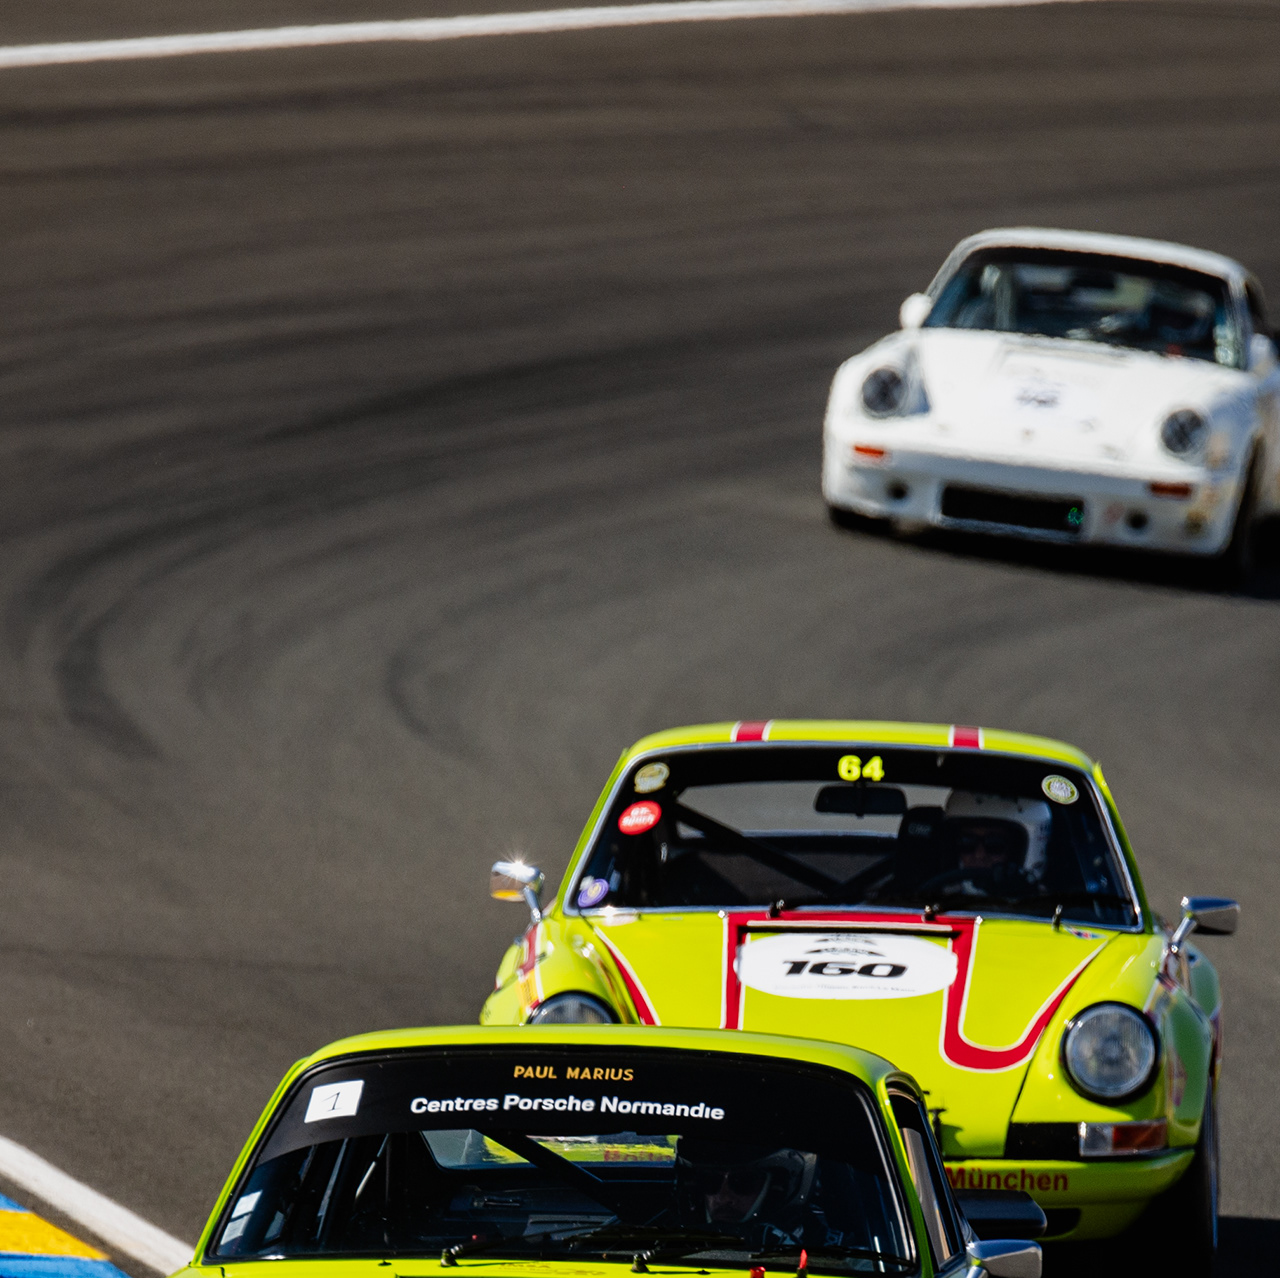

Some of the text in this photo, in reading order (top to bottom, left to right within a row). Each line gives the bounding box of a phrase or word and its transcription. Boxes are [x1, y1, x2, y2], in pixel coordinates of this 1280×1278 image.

[837, 754, 885, 782] 64
[783, 960, 908, 978] 160
[513, 1066, 634, 1081] PAUL MARIUS
[410, 1097, 499, 1115] Centres
[503, 1095, 595, 1113] Porsche
[945, 1167, 1068, 1191] München
